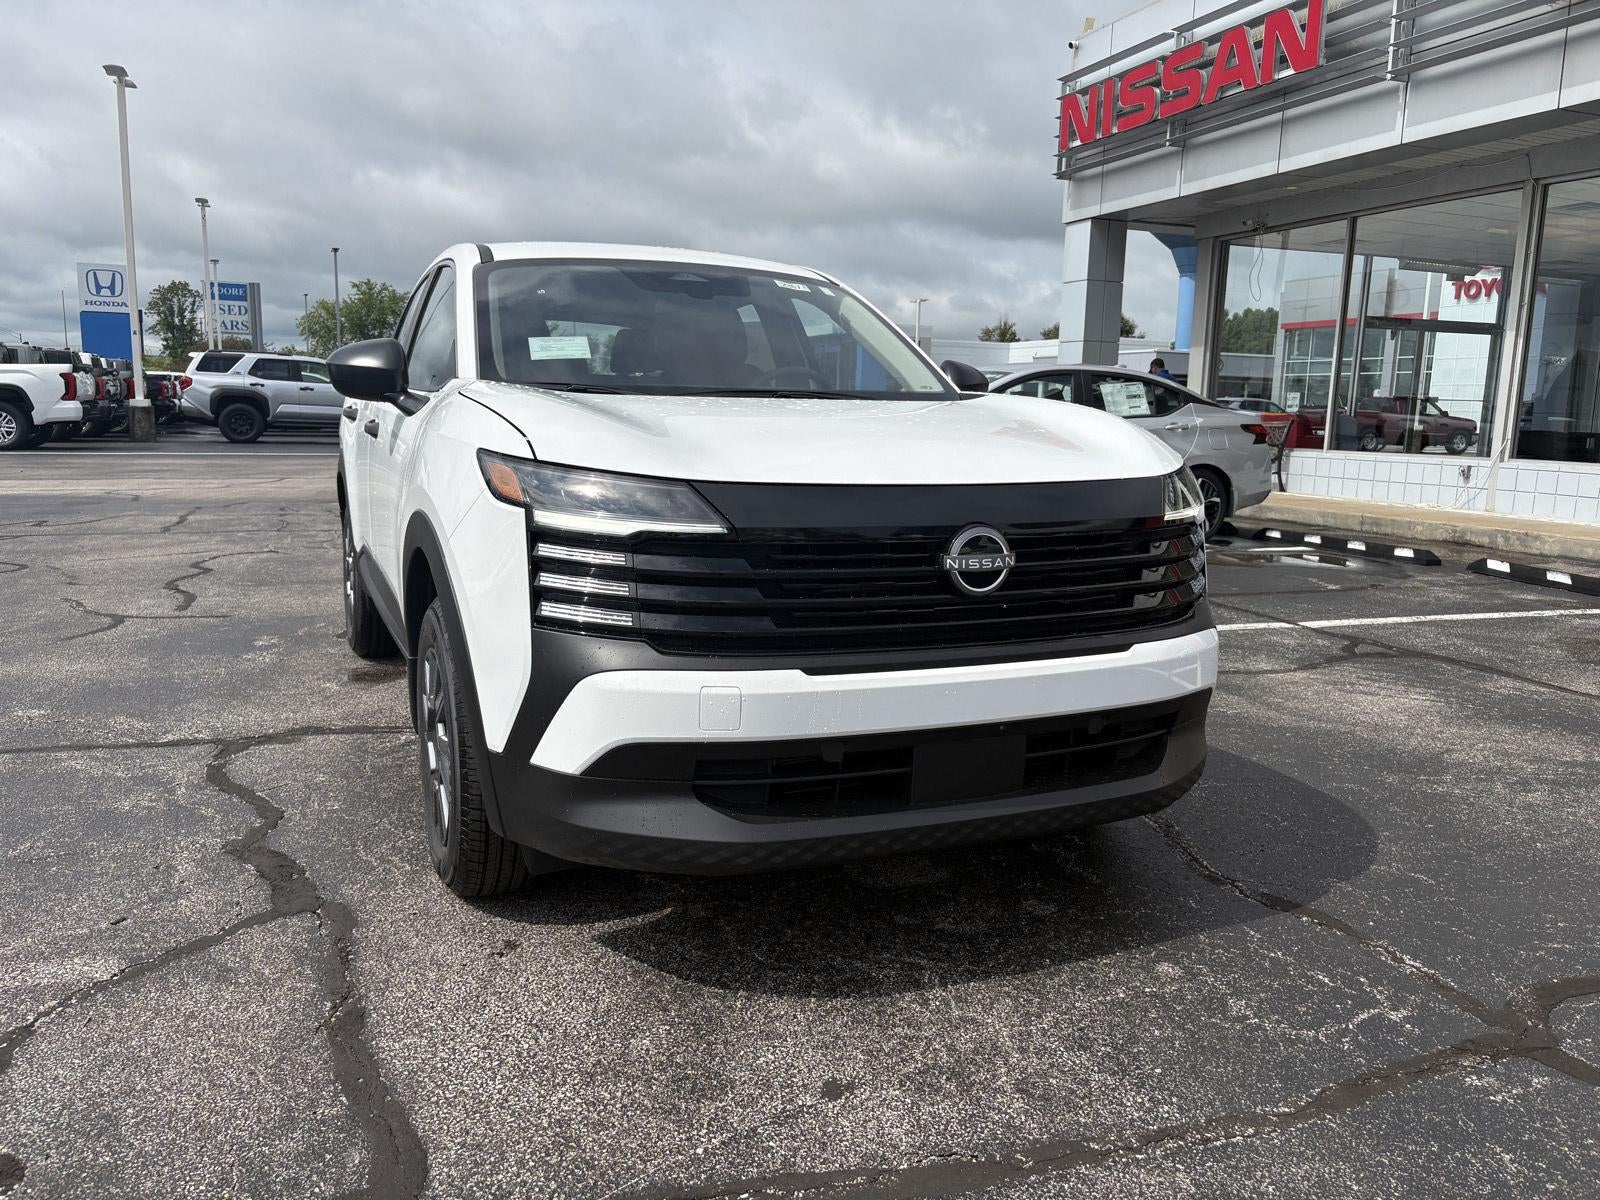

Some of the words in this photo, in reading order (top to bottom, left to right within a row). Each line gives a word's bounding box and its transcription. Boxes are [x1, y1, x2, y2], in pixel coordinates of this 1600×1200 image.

[1060, 0, 1325, 152] NISSAN
[84, 299, 129, 308] HONDA
[946, 556, 1015, 569] NISSAN
